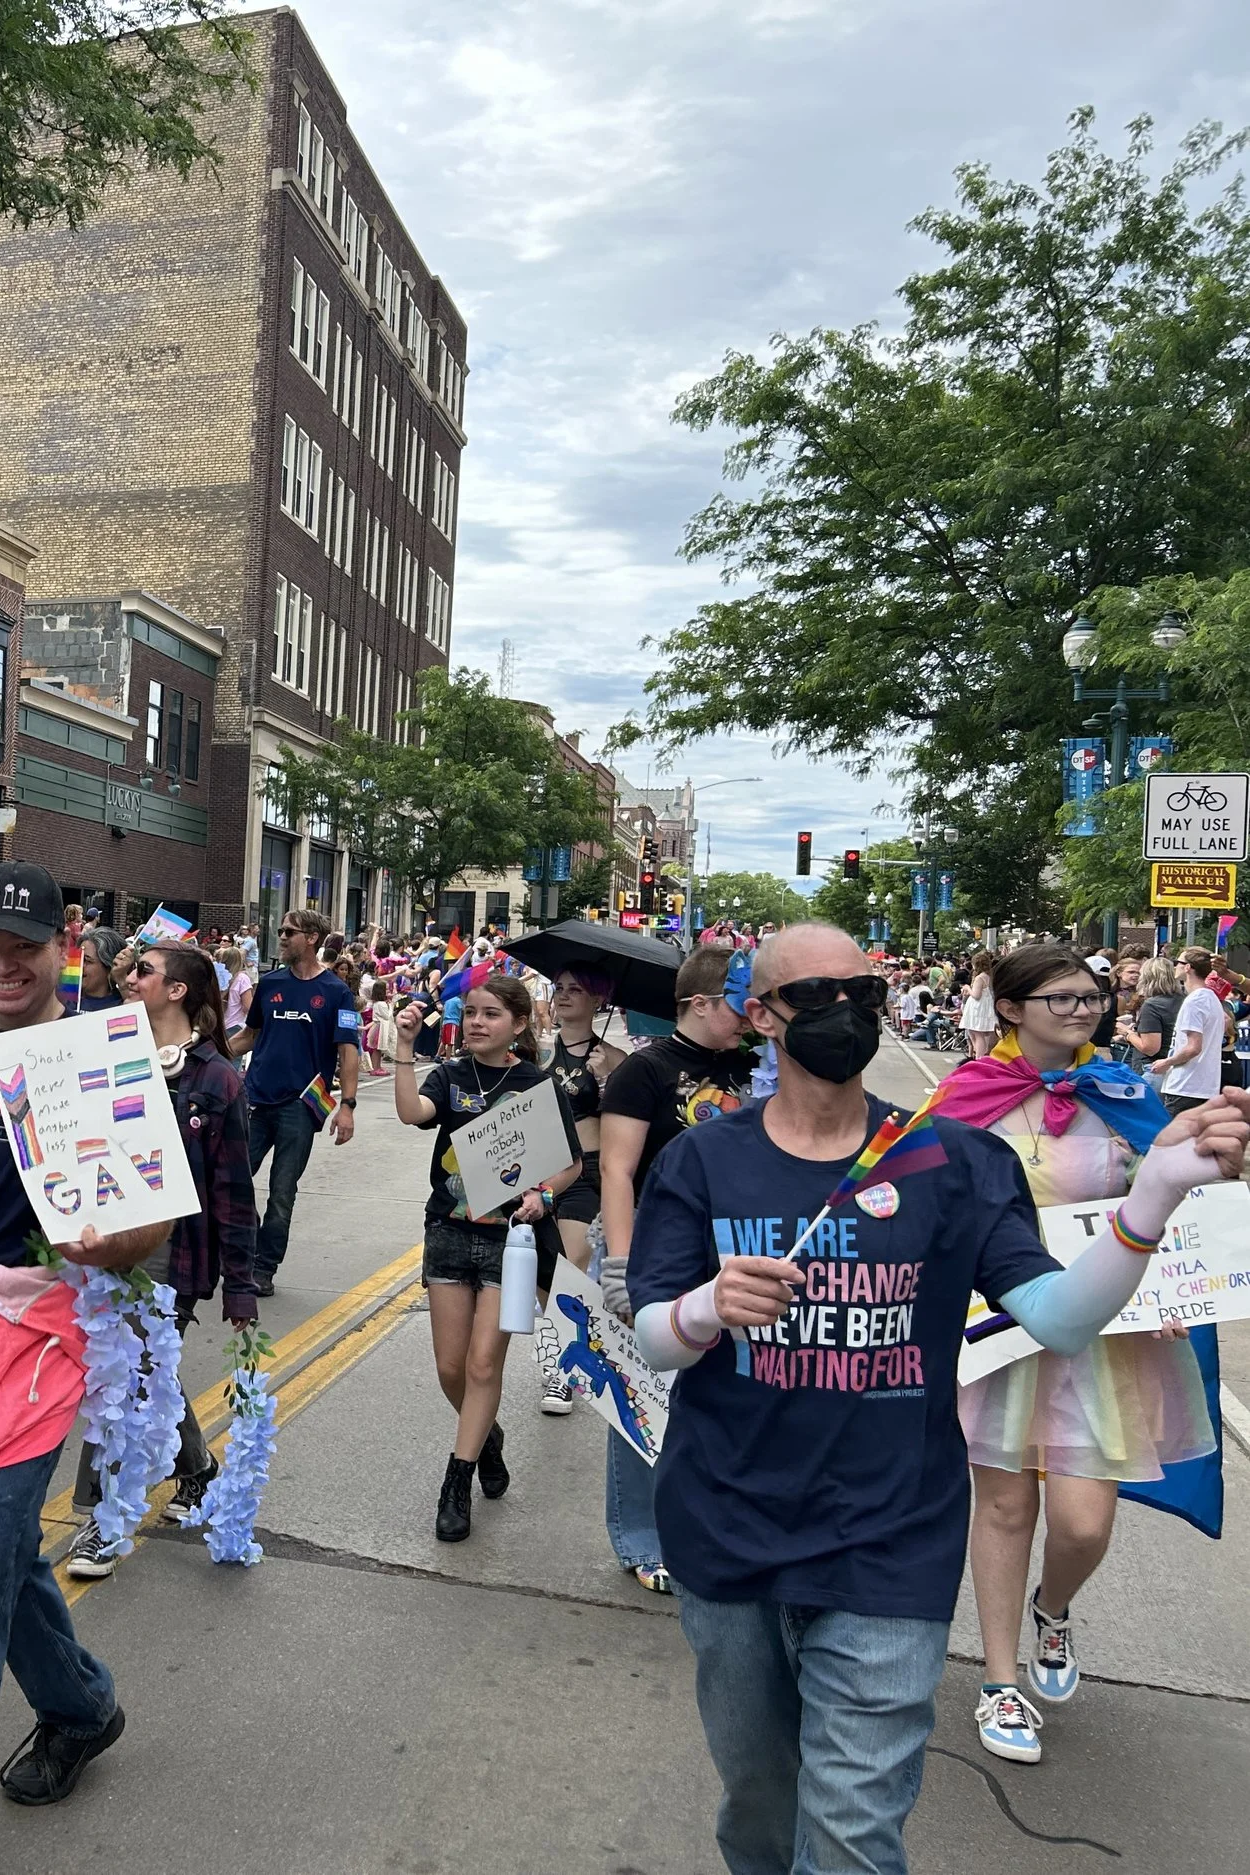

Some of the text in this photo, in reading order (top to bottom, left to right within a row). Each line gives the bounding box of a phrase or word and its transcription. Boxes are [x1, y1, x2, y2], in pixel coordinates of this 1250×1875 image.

[1073, 755, 1096, 764] DTSF
[1161, 818, 1230, 831] MAY USE
[1153, 837, 1237, 851] FULL LANE
[1161, 866, 1226, 877] HISTORICAL
[1161, 876, 1225, 886] MARKER
[625, 891, 675, 911] STE
[273, 1010, 312, 1023] USA
[25, 1048, 74, 1070] Shade
[34, 1079, 65, 1097] never
[38, 1119, 79, 1136] anybody
[468, 1098, 534, 1145] Harry Potter
[46, 1139, 66, 1153] less
[485, 1130, 525, 1159] nobody
[44, 1149, 163, 1215] GAY
[733, 1217, 859, 1258] WE ARE
[1161, 1259, 1207, 1278] NYLA
[806, 1261, 924, 1304] CHANGE
[1127, 1290, 1161, 1306] UCY
[1159, 1301, 1216, 1324] PRIDE
[846, 1304, 913, 1347] BEEN
[751, 1343, 924, 1392] WAITING FOR
[638, 1380, 670, 1414] Gende
